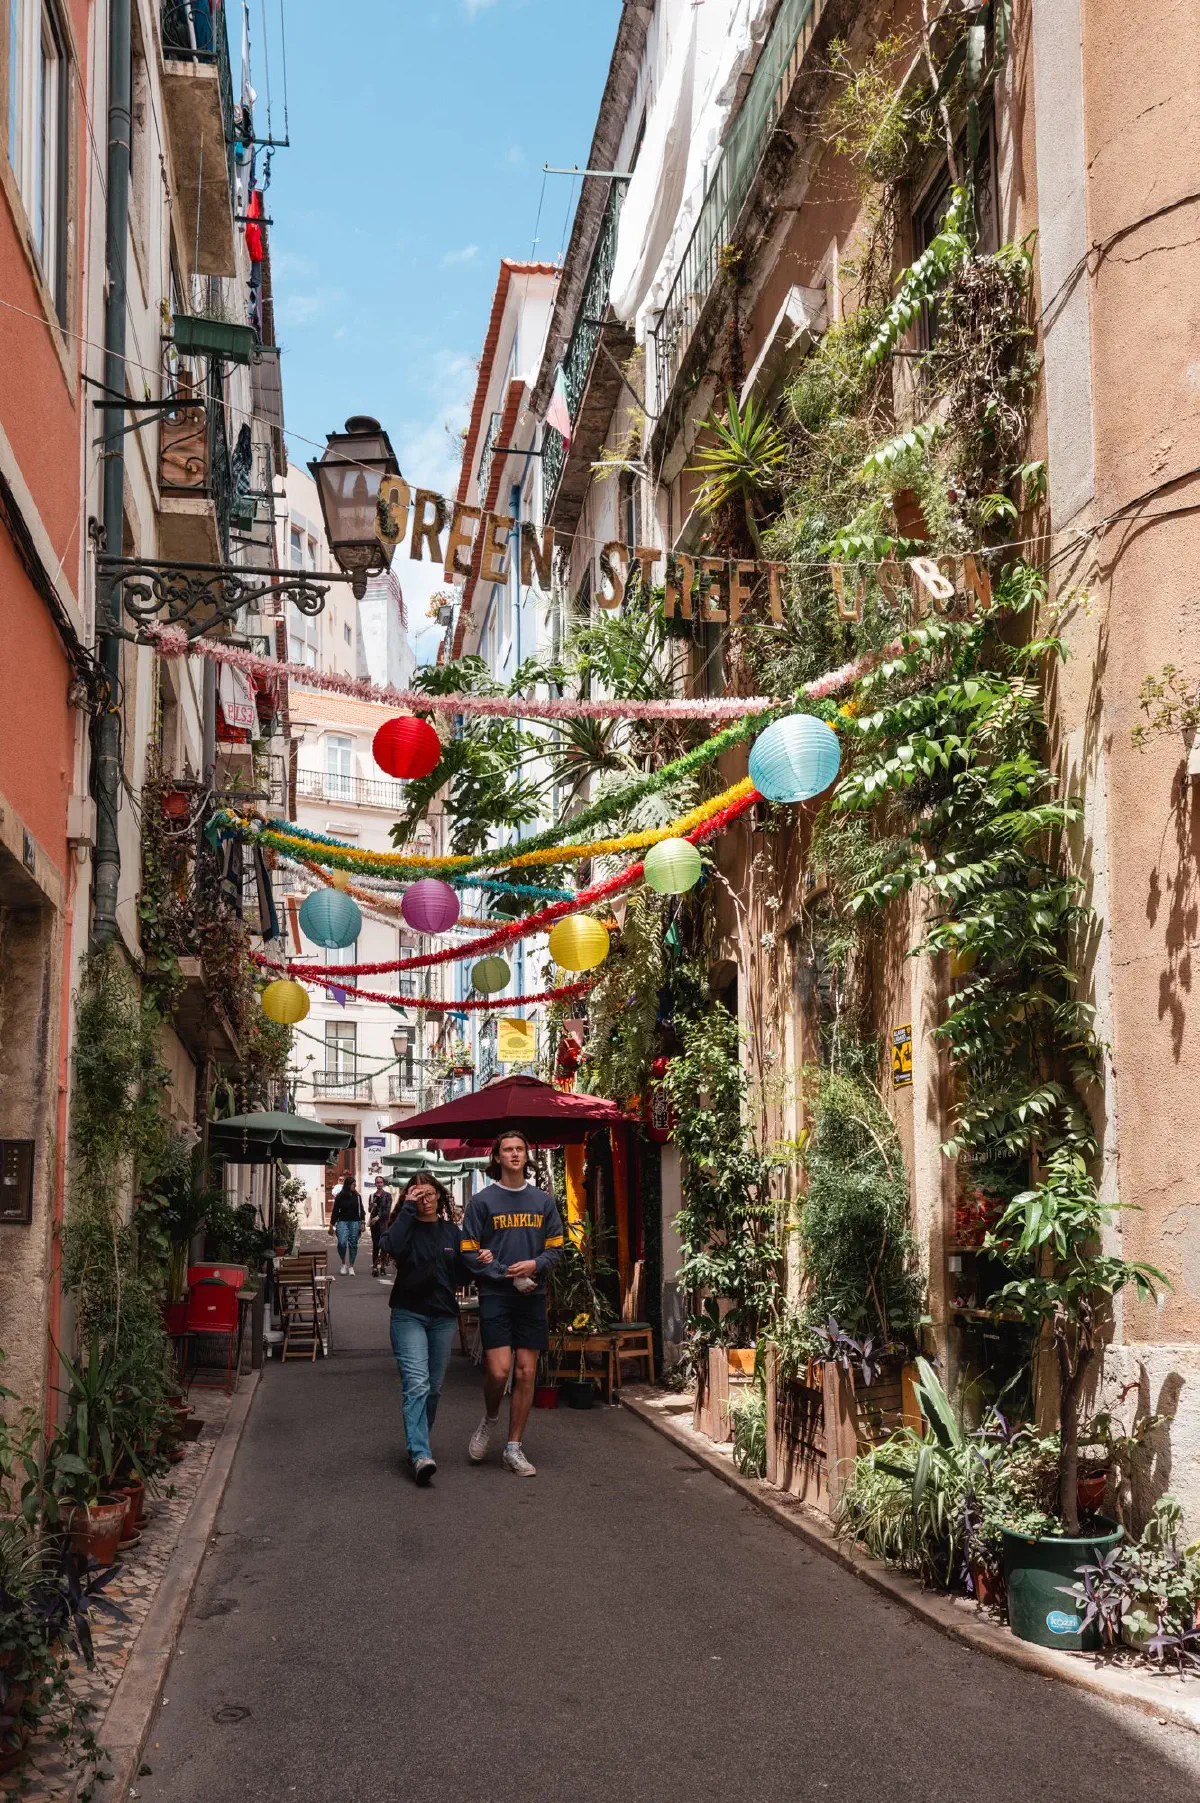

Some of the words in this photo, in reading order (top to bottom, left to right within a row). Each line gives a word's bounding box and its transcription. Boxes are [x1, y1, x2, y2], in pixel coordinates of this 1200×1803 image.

[374, 475, 555, 591] GREEN
[595, 541, 788, 625] STREET
[831, 553, 992, 622] LISBON
[492, 1213, 544, 1230] FRANKLIN
